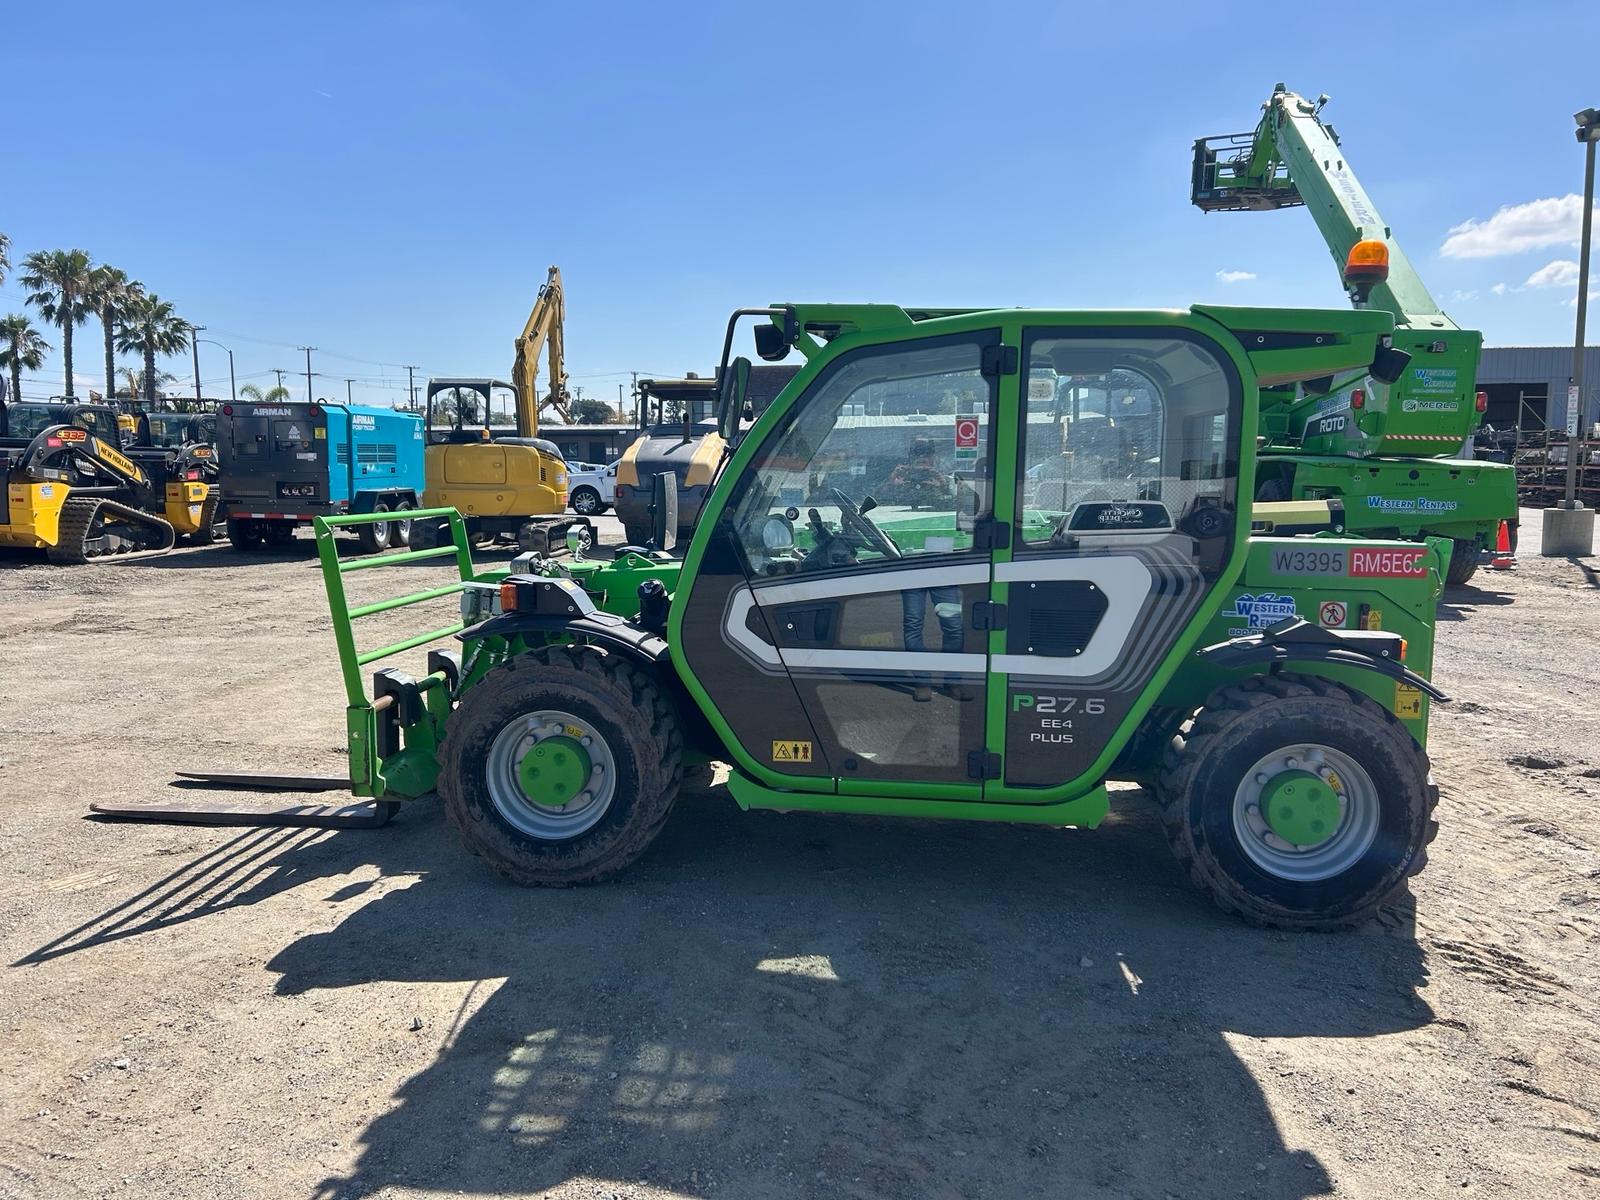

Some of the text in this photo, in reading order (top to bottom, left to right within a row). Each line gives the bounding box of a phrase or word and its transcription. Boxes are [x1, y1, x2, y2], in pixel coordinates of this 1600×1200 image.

[252, 408, 292, 416] AIRMAN
[352, 414, 375, 425] AIRMAN
[1319, 416, 1345, 433] ROTO
[100, 446, 134, 473] NEW HOLLAND
[1368, 496, 1457, 510] WESTERN RENTALS
[1275, 551, 1343, 573] W3395
[1236, 602, 1295, 616] WESTERN
[1013, 694, 1105, 714] P27.6
[1041, 719, 1072, 728] EE4
[1030, 733, 1073, 743] PLUS
